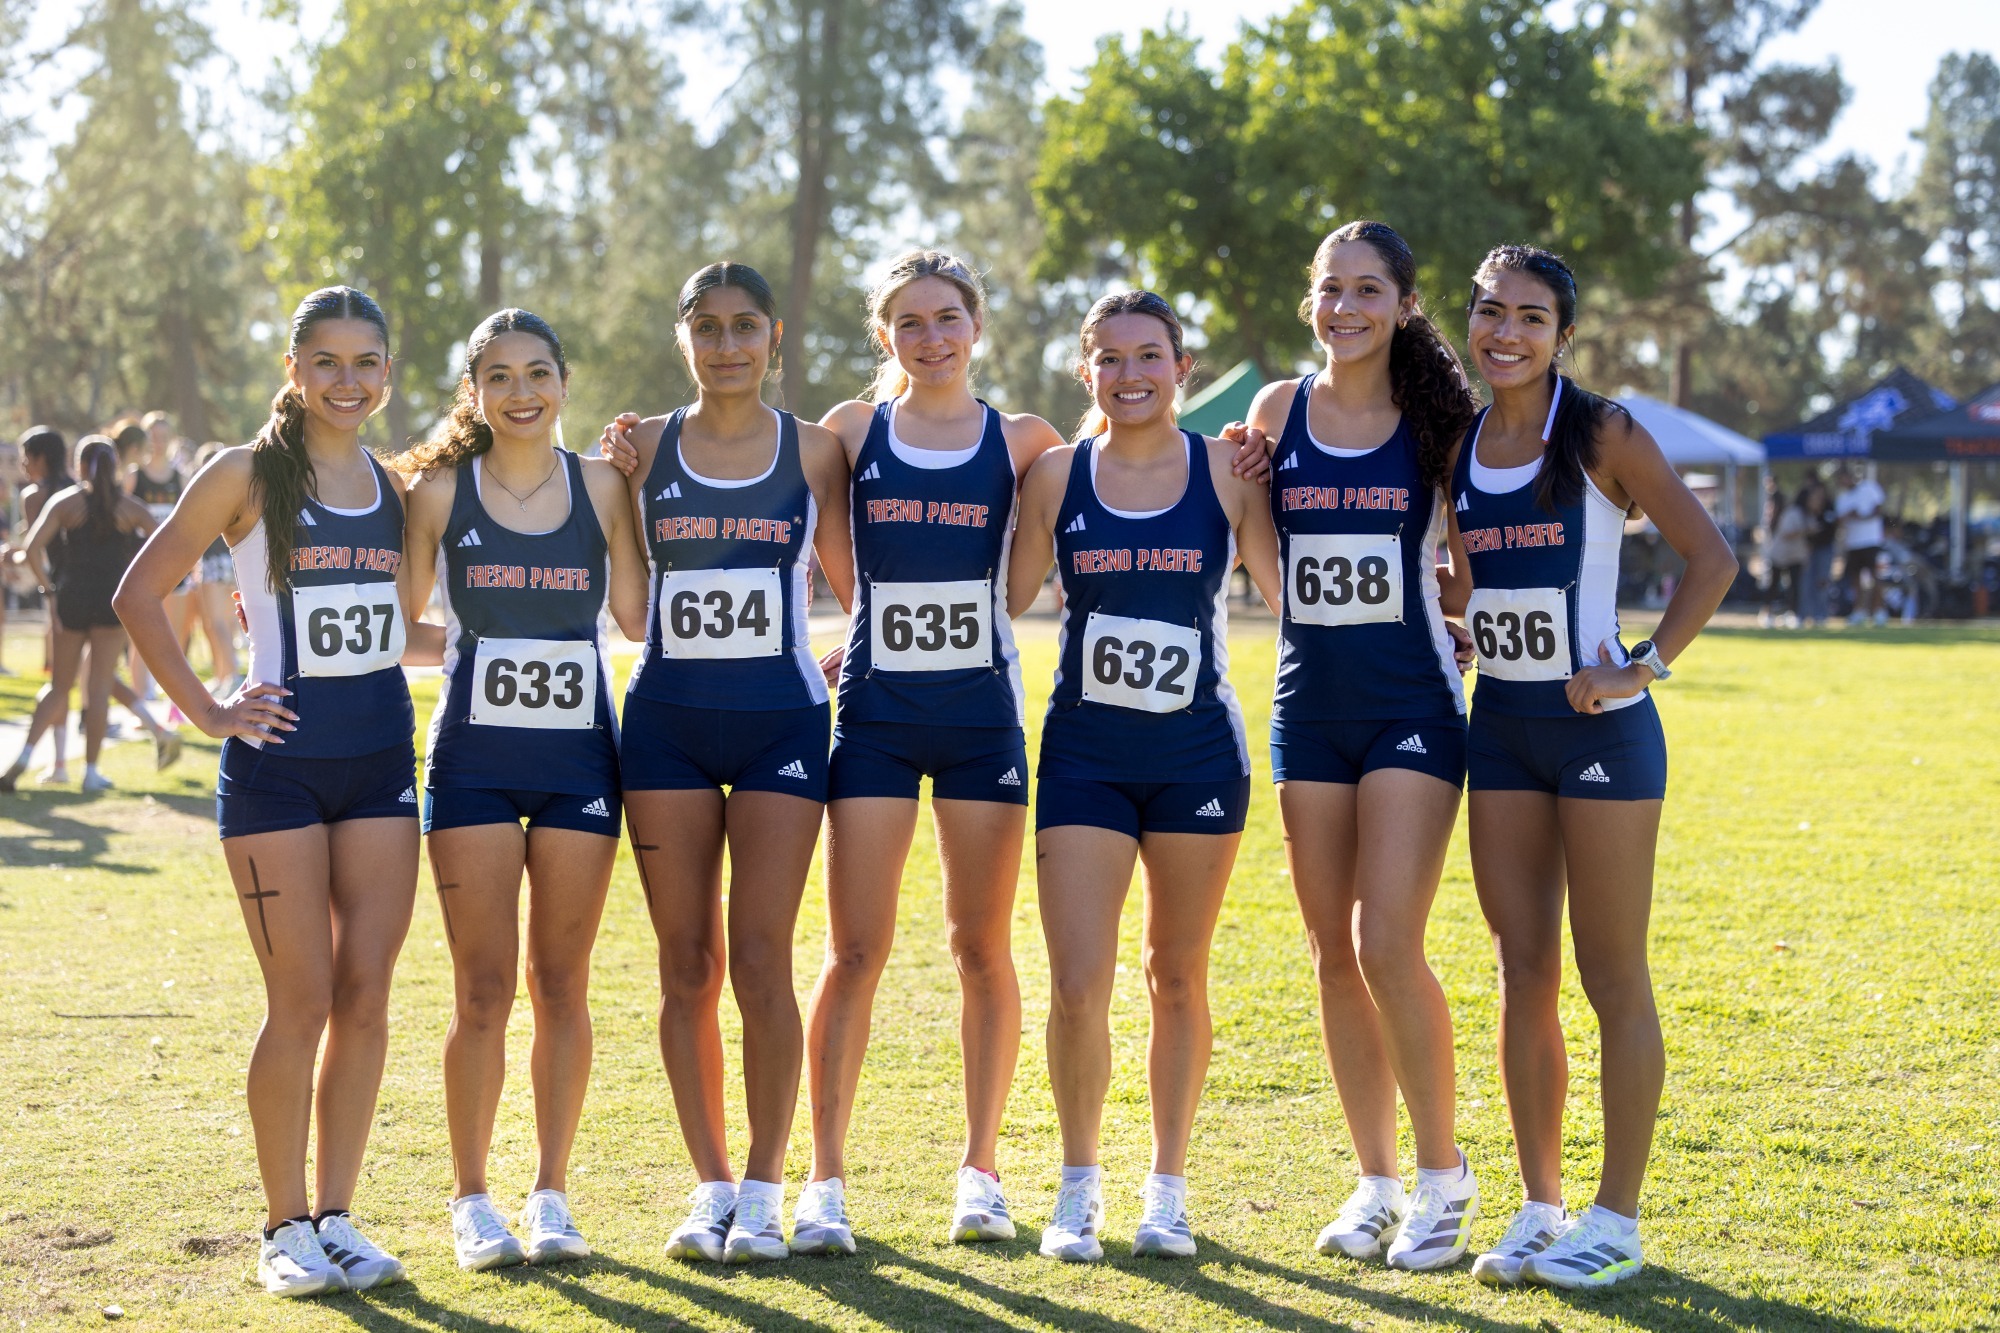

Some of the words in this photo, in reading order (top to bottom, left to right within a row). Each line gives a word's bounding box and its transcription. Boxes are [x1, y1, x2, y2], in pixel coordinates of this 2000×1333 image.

[1281, 485, 1338, 512] FRESNO
[1342, 486, 1409, 512] PACIFIC
[866, 498, 923, 524] FRESNO
[927, 501, 989, 528] PACIFIC
[655, 516, 717, 543] FRESNO
[722, 517, 791, 544] PACIFIC
[1460, 527, 1503, 554] RESNO
[1504, 523, 1565, 549] PACIFIC
[289, 545, 351, 572] FRESNO
[1073, 548, 1132, 574] FRESNO
[1136, 548, 1203, 573] PACIFIC
[466, 564, 526, 589] FRESNO
[529, 566, 590, 591] PACIFIC
[1295, 555, 1390, 606] 638
[669, 589, 770, 639] 634
[881, 603, 980, 652] 635
[307, 603, 395, 658] 637
[1472, 610, 1556, 662] 636
[1092, 636, 1190, 696] 632
[484, 658, 584, 709] 633
[1396, 741, 1427, 754] adidas
[777, 768, 808, 780] adidas
[998, 775, 1021, 786] adidas
[1579, 771, 1610, 784] adidas
[582, 805, 610, 817] adidas
[1195, 807, 1225, 817] adidas
